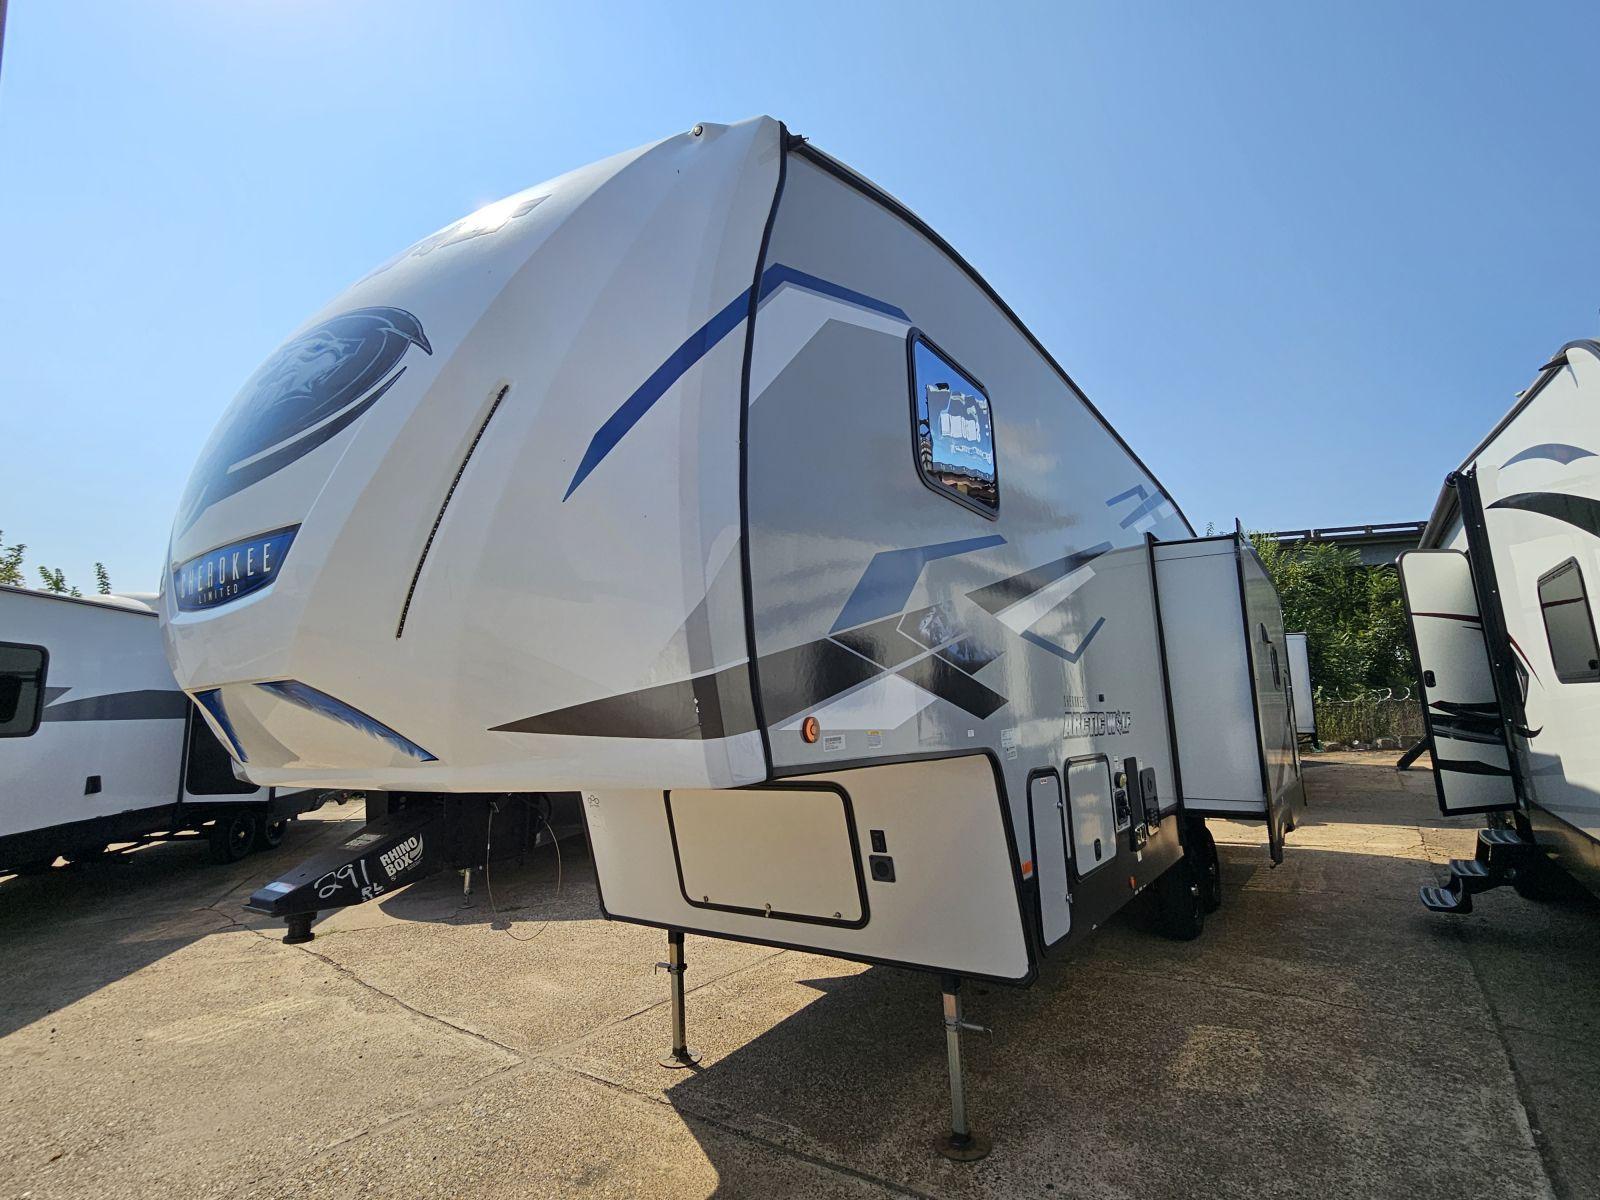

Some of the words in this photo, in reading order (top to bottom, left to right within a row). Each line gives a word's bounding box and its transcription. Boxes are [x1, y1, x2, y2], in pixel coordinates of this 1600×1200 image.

[180, 543, 271, 598] CHEROKEE
[198, 583, 239, 604] LIMITED
[1063, 711, 1105, 739] ARCTIC
[380, 836, 418, 867] RHINO
[384, 853, 413, 877] BOX
[313, 859, 370, 899] 291
